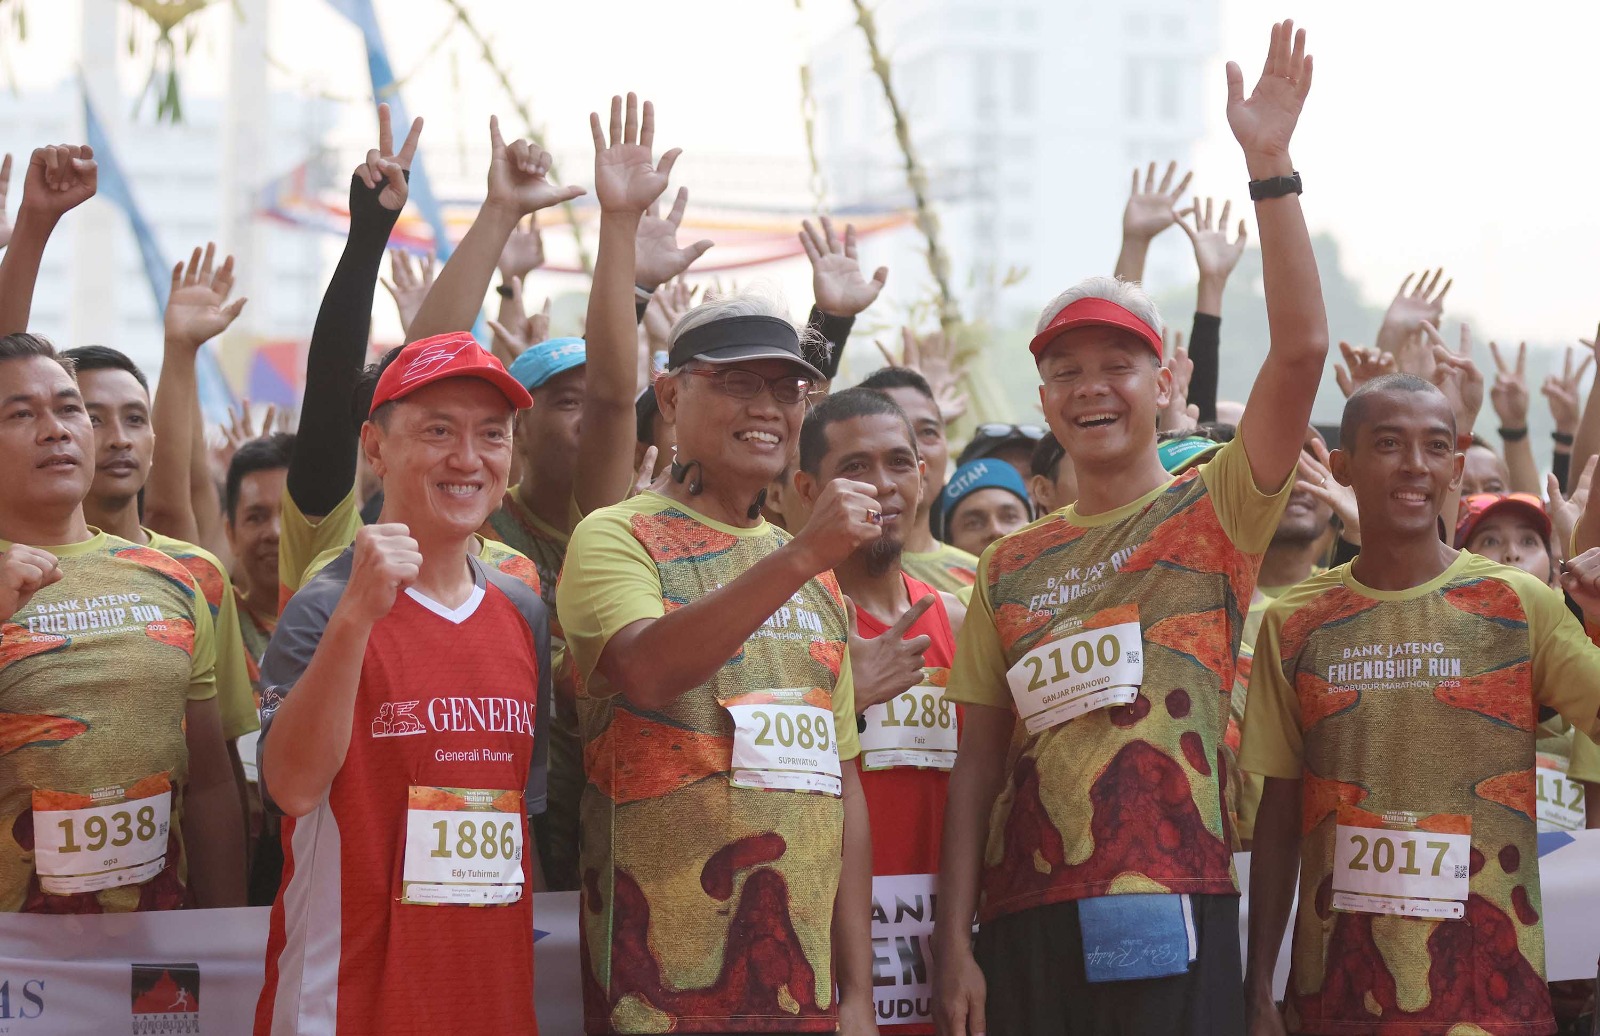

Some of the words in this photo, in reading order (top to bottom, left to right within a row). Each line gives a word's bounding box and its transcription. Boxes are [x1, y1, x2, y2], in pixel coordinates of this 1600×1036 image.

[36, 600, 80, 614] BANK
[85, 593, 141, 611] JATENG
[27, 607, 127, 633] FRIENDSHIP
[131, 605, 164, 622] RUN
[90, 625, 140, 637] MARATHON
[147, 624, 168, 632] 2023
[1343, 644, 1383, 659] BANK
[1387, 642, 1445, 658] JATENG
[1022, 633, 1121, 693] 2100
[1328, 658, 1422, 684] FRIENDSHIP
[1428, 658, 1461, 677] RUN
[1041, 687, 1070, 705] GANJAR
[1070, 675, 1111, 694] PRANOWO
[1327, 683, 1380, 694] BOROBUDUR
[1381, 680, 1430, 690] MARATHON
[1438, 680, 1461, 688] 2023
[881, 693, 951, 730] 1288
[751, 710, 830, 752] 2089
[434, 748, 480, 763] Generali
[483, 748, 515, 763] Runner
[57, 805, 156, 854] 1938
[430, 819, 515, 860] 1886
[103, 857, 118, 867] opa
[1348, 834, 1450, 877] 2017
[451, 869, 467, 879] Edy
[467, 869, 500, 879] Tuhirman
[132, 1020, 199, 1031] BOROBUDUR
[133, 1027, 200, 1035] MARATHON
